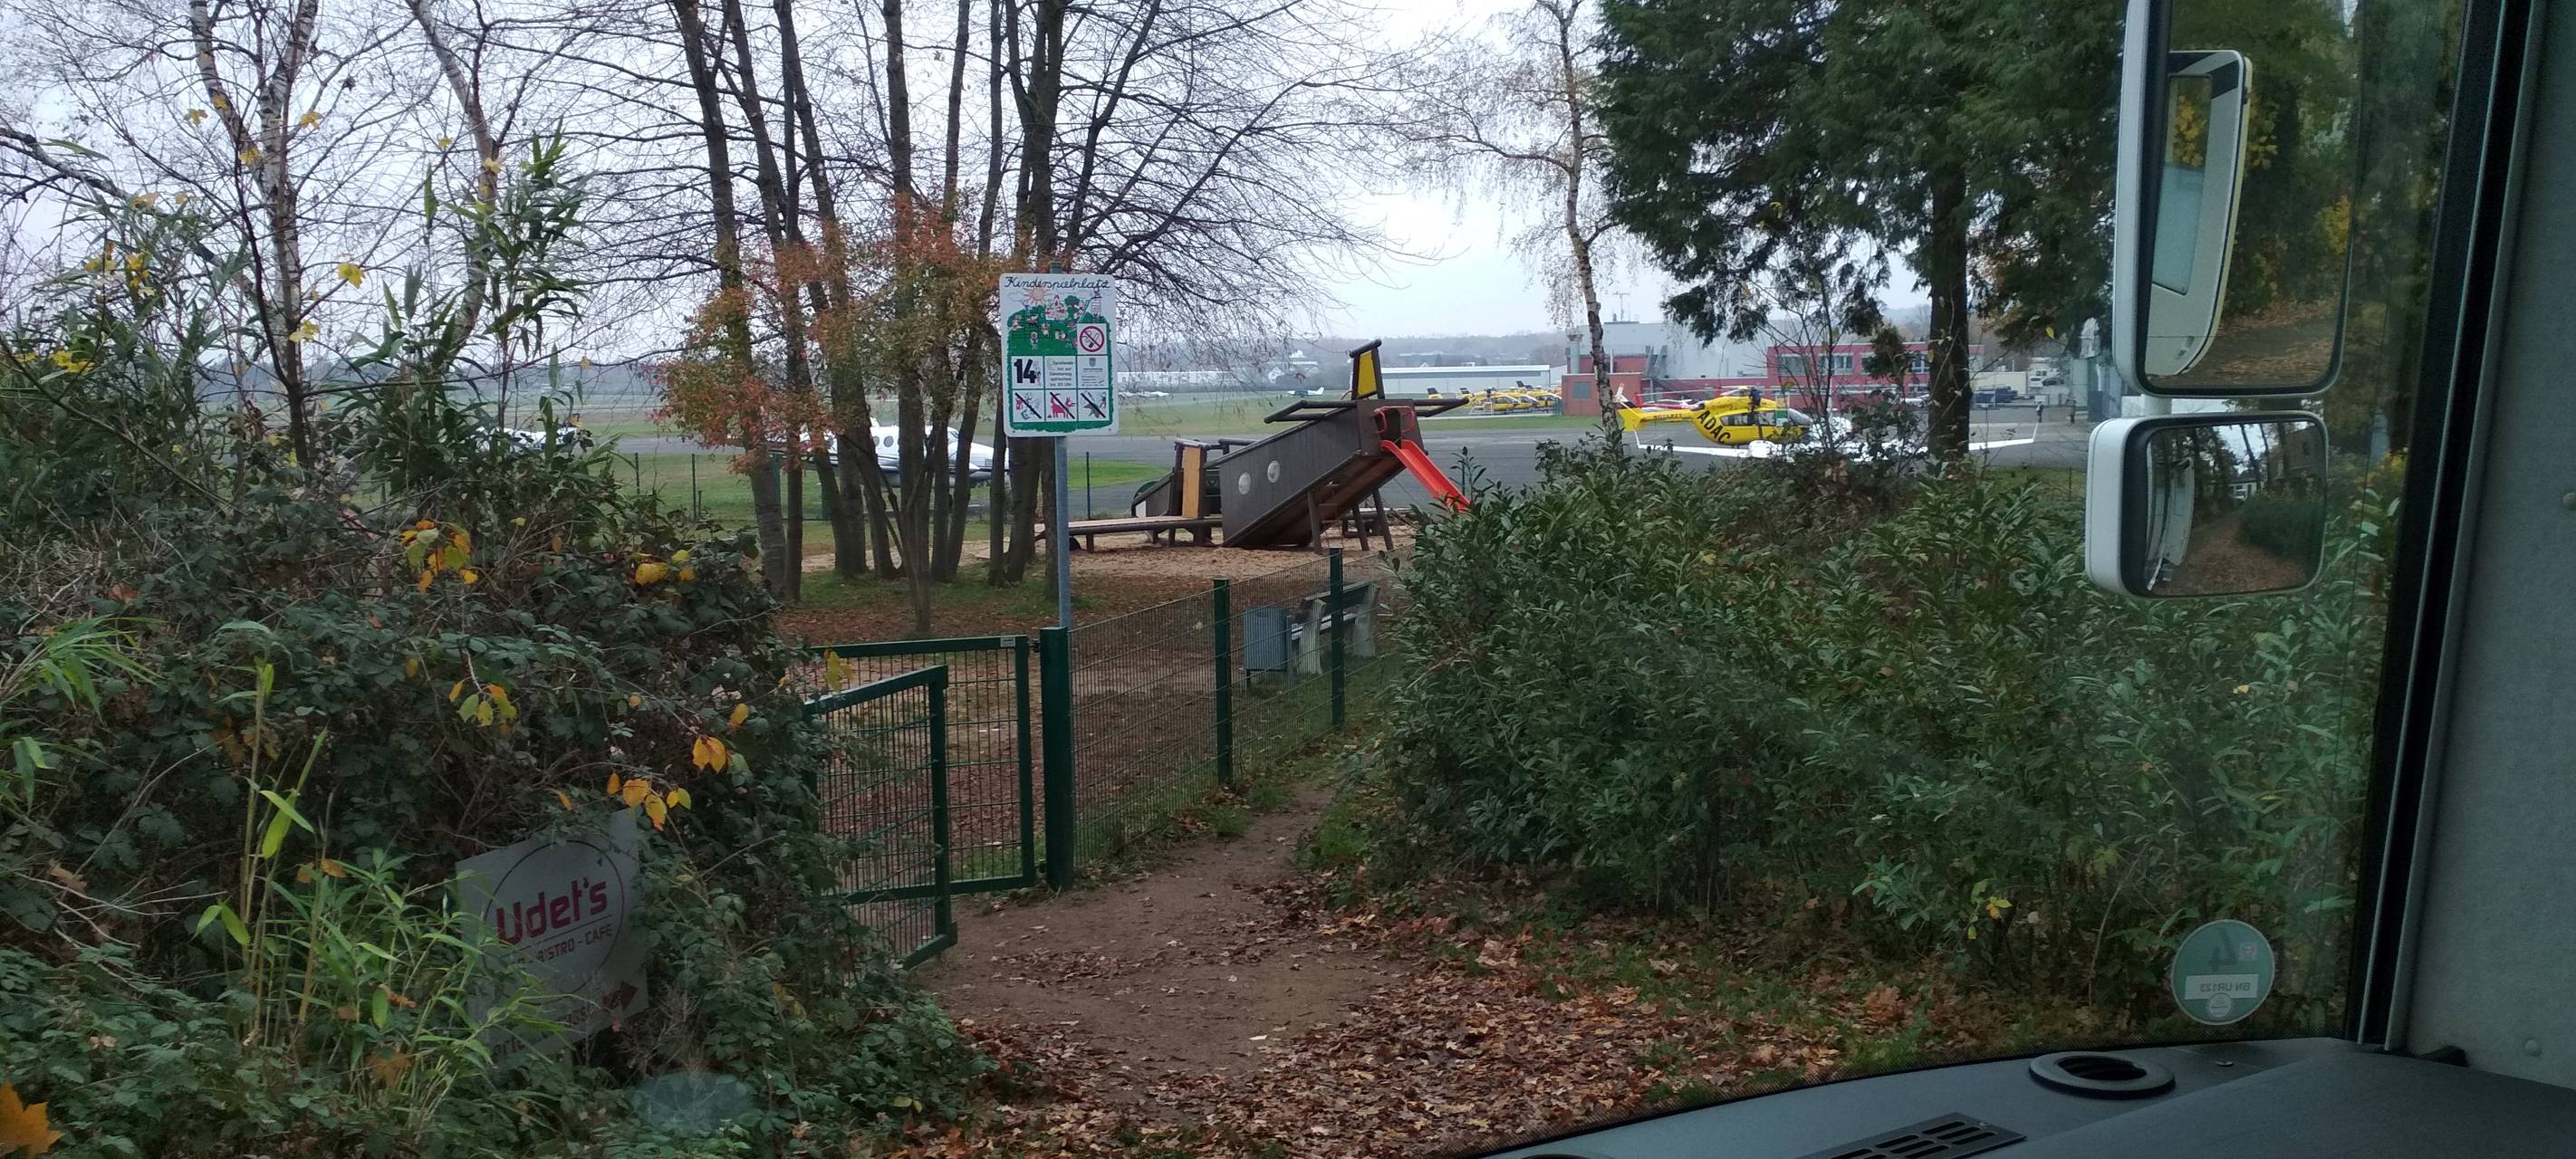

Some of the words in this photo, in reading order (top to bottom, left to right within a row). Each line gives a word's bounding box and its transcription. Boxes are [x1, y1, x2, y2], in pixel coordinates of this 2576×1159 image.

[1004, 275, 1110, 292] Kinderspielplatz
[1014, 359, 1037, 384] 14
[1696, 409, 1731, 444] ADAC
[495, 876, 608, 946] Udet's
[584, 923, 613, 945] CAFE
